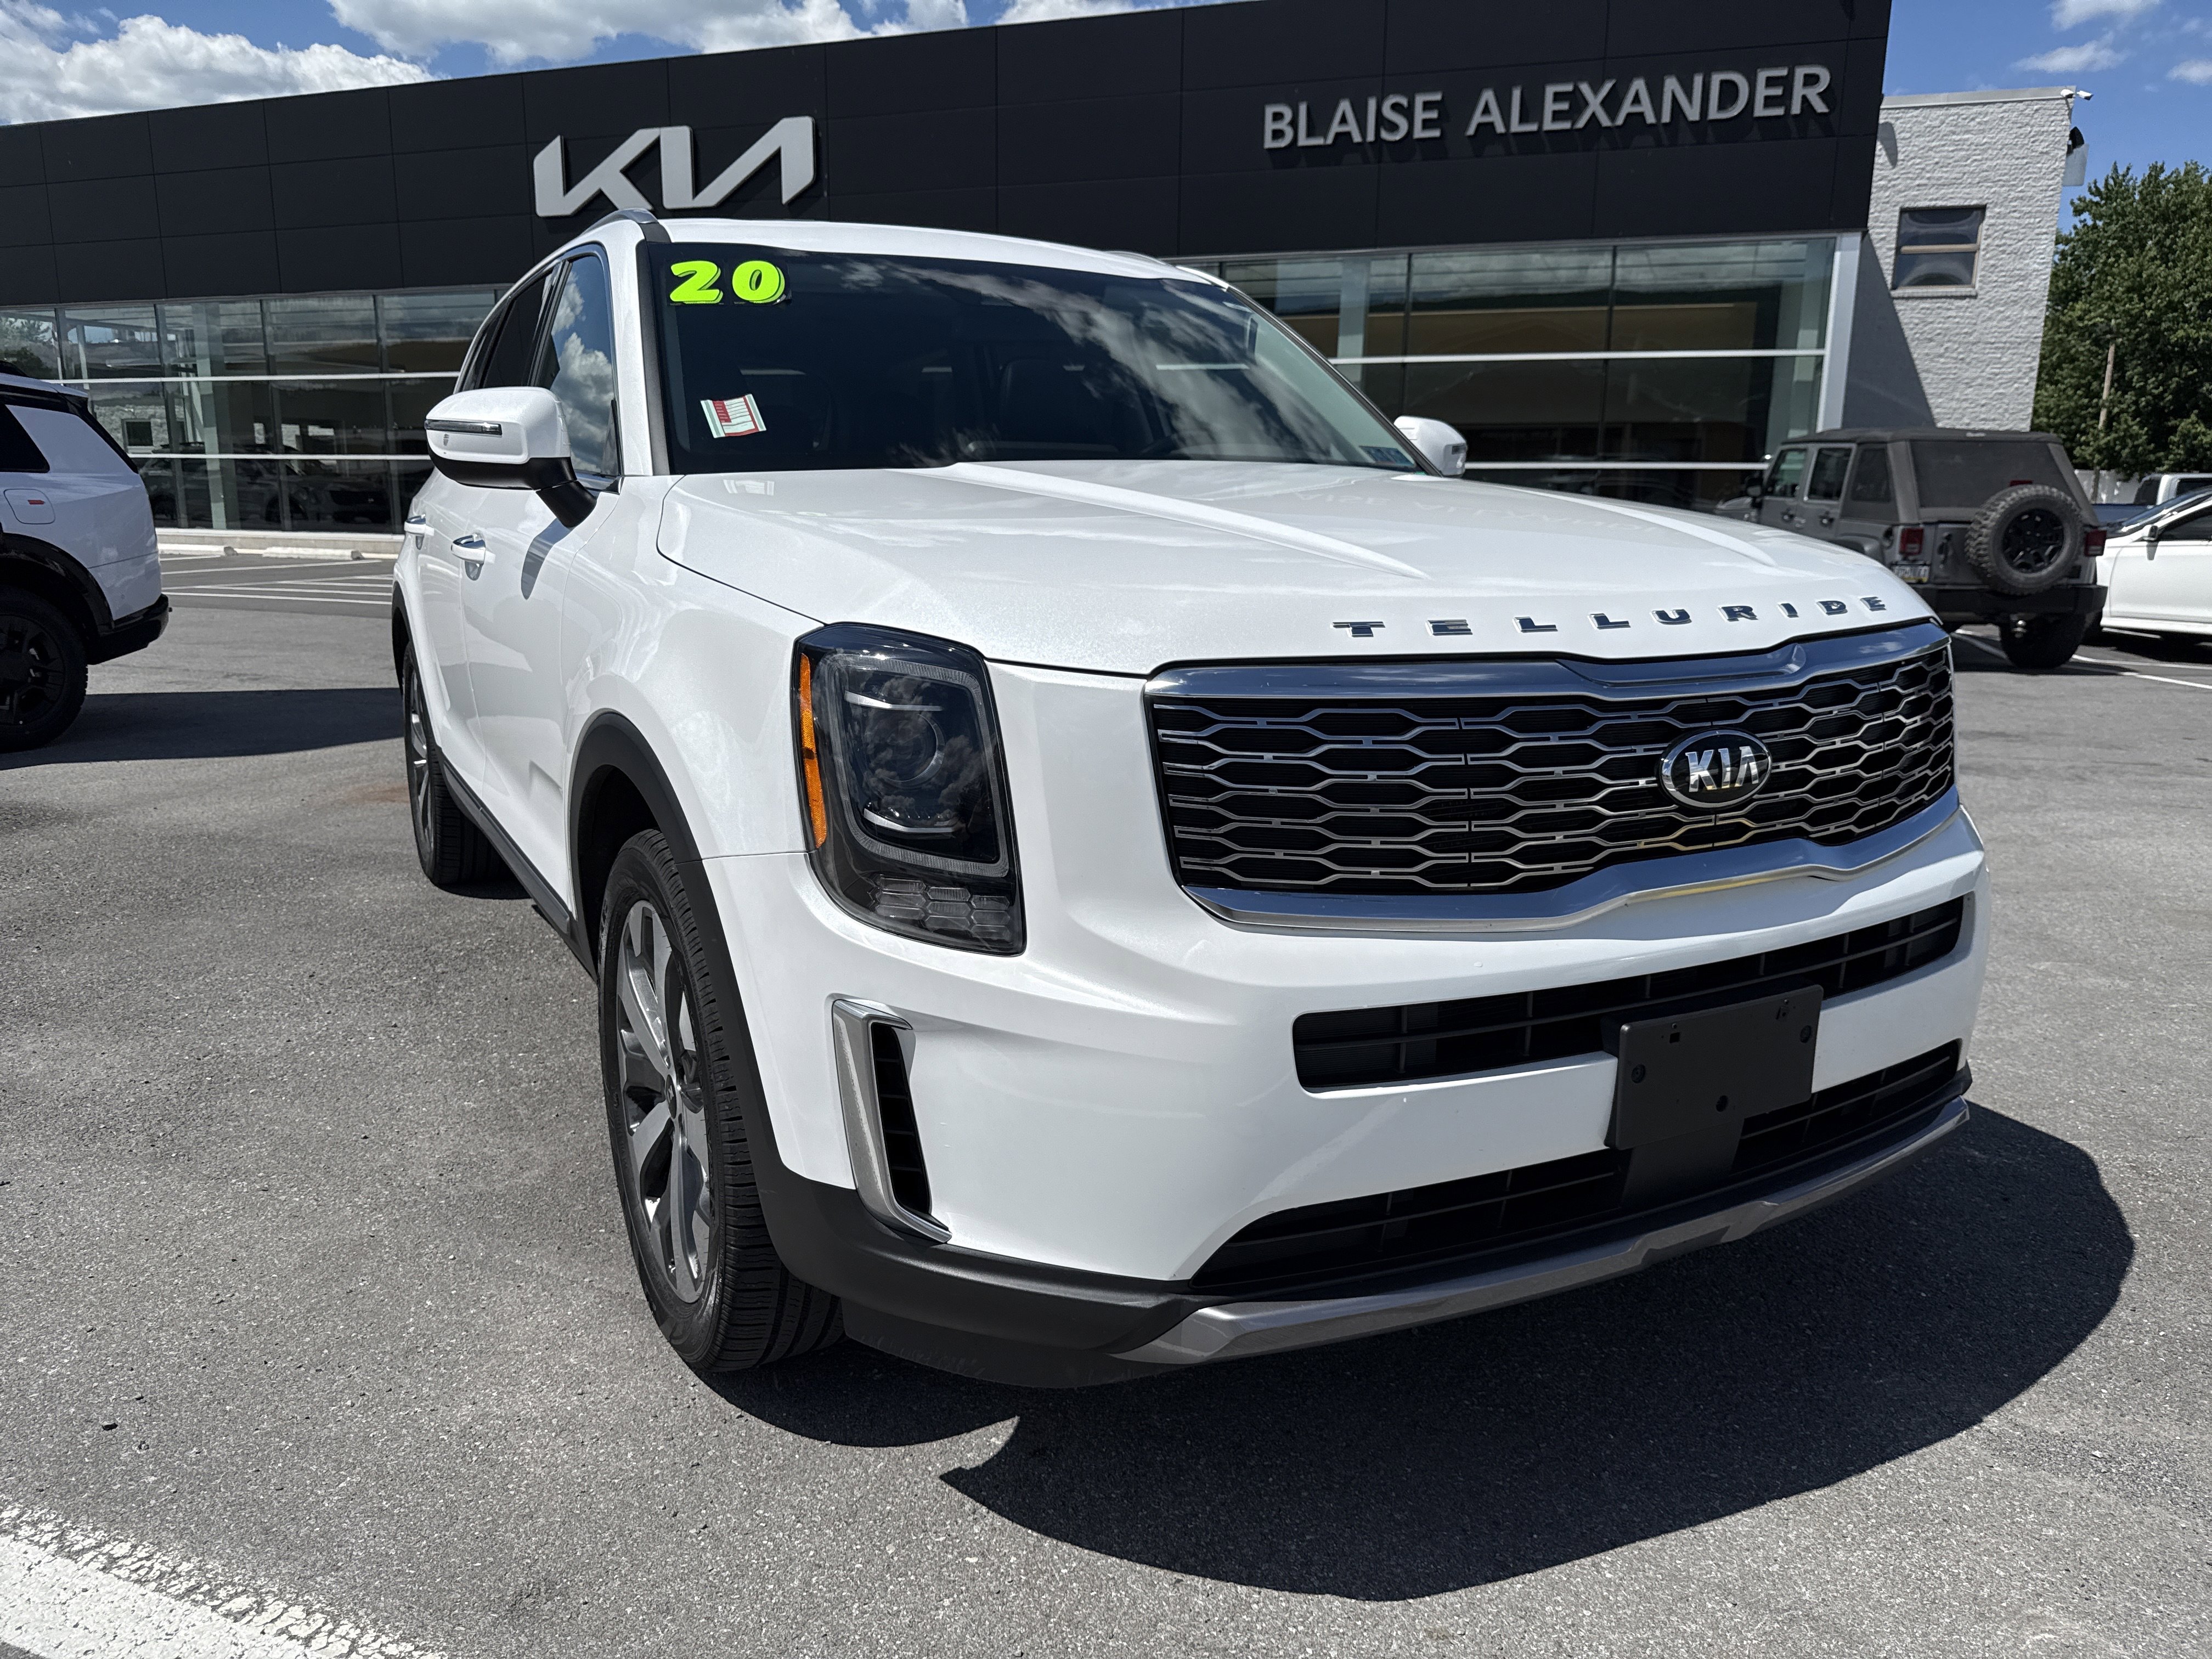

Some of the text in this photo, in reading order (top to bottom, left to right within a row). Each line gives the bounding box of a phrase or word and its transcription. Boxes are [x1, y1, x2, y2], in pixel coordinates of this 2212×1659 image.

[1263, 64, 1831, 149] BLAISE ALEXANDER
[669, 260, 785, 304] 20
[1331, 596, 1887, 638] TELLURIDE
[1685, 746, 1759, 793] KIA
